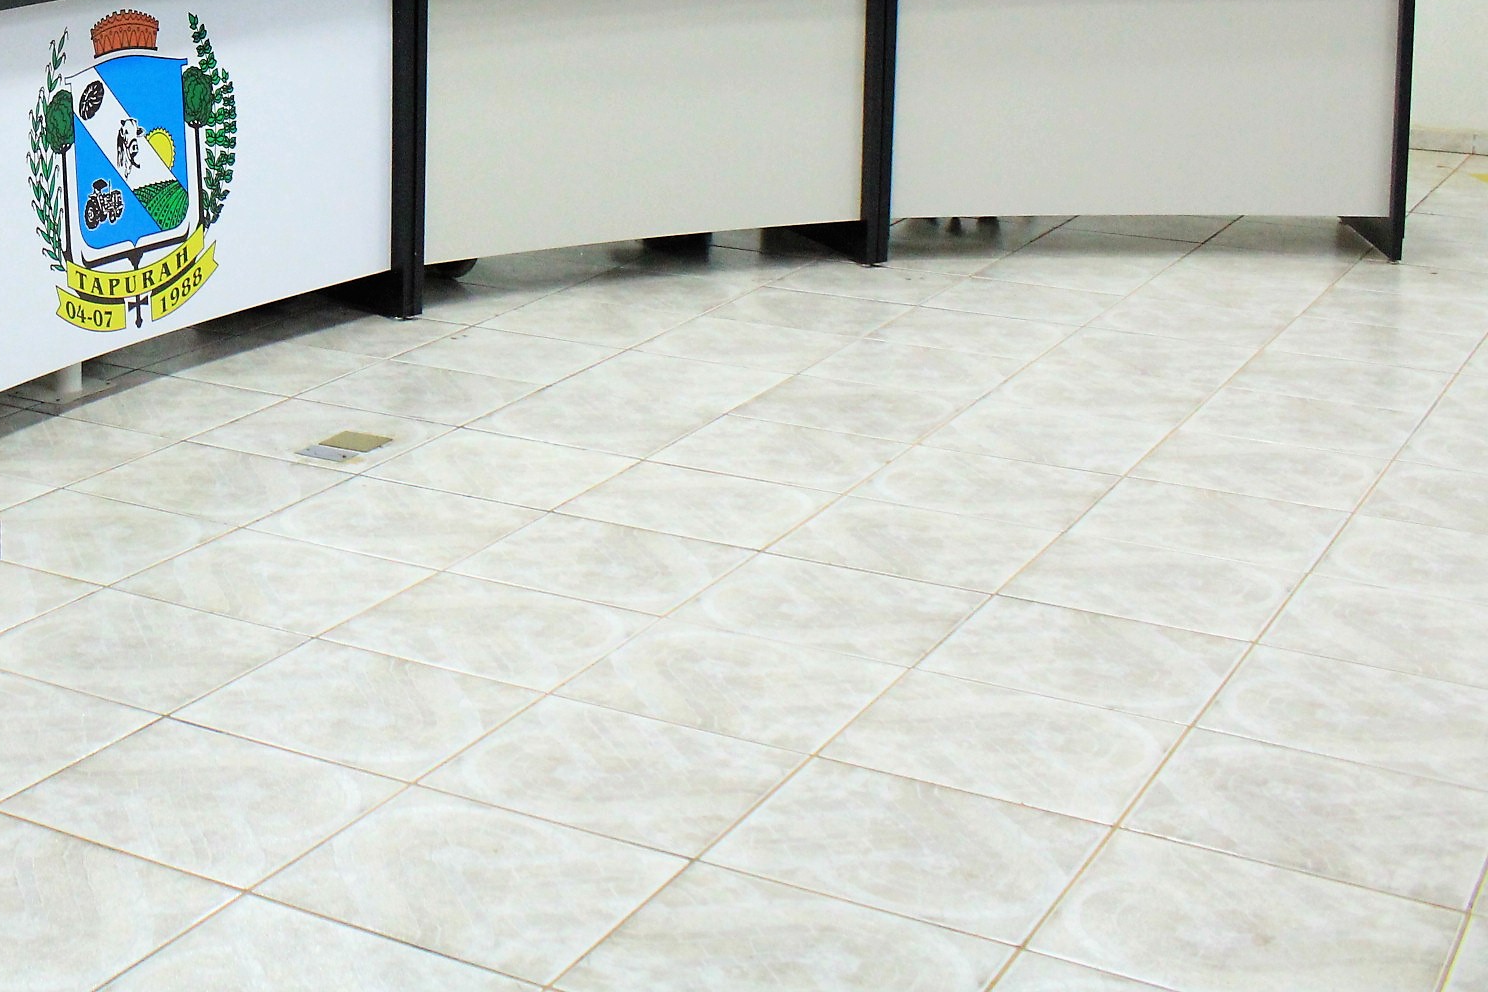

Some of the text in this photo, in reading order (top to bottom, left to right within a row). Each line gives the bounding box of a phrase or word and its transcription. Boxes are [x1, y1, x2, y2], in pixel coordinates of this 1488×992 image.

[75, 246, 189, 296] TAPURAH
[160, 266, 203, 313] 1988
[65, 300, 113, 328] 04-07
